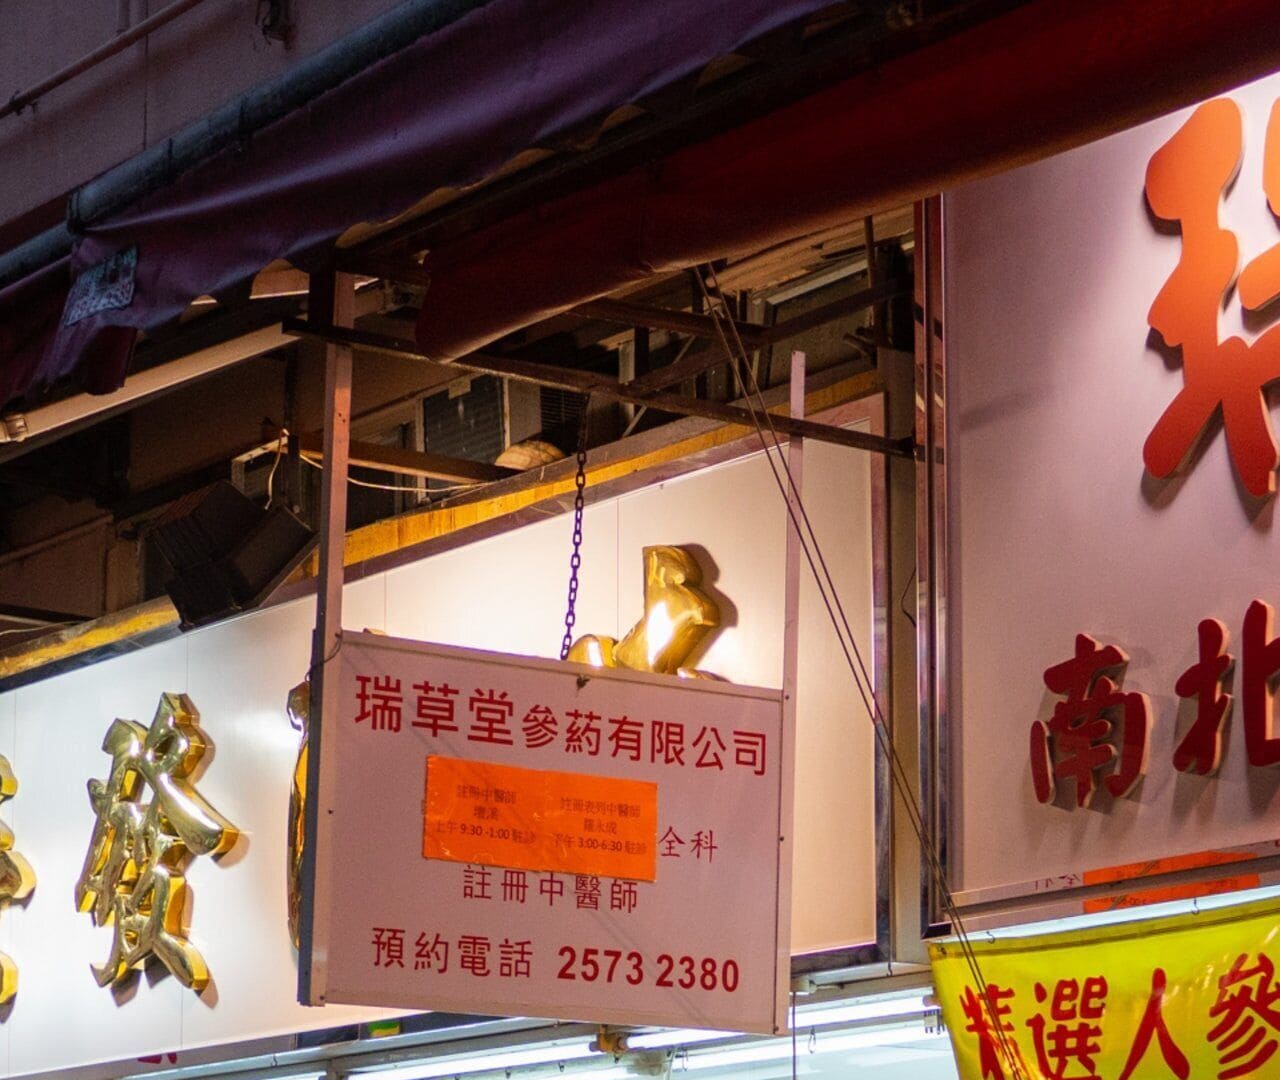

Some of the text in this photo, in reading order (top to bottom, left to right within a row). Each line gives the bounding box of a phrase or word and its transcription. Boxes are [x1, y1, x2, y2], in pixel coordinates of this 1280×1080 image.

[659, 825, 718, 863] 全科
[462, 866, 637, 913] 註冊中醫師
[372, 927, 739, 993] 預約電話 2573 2380
